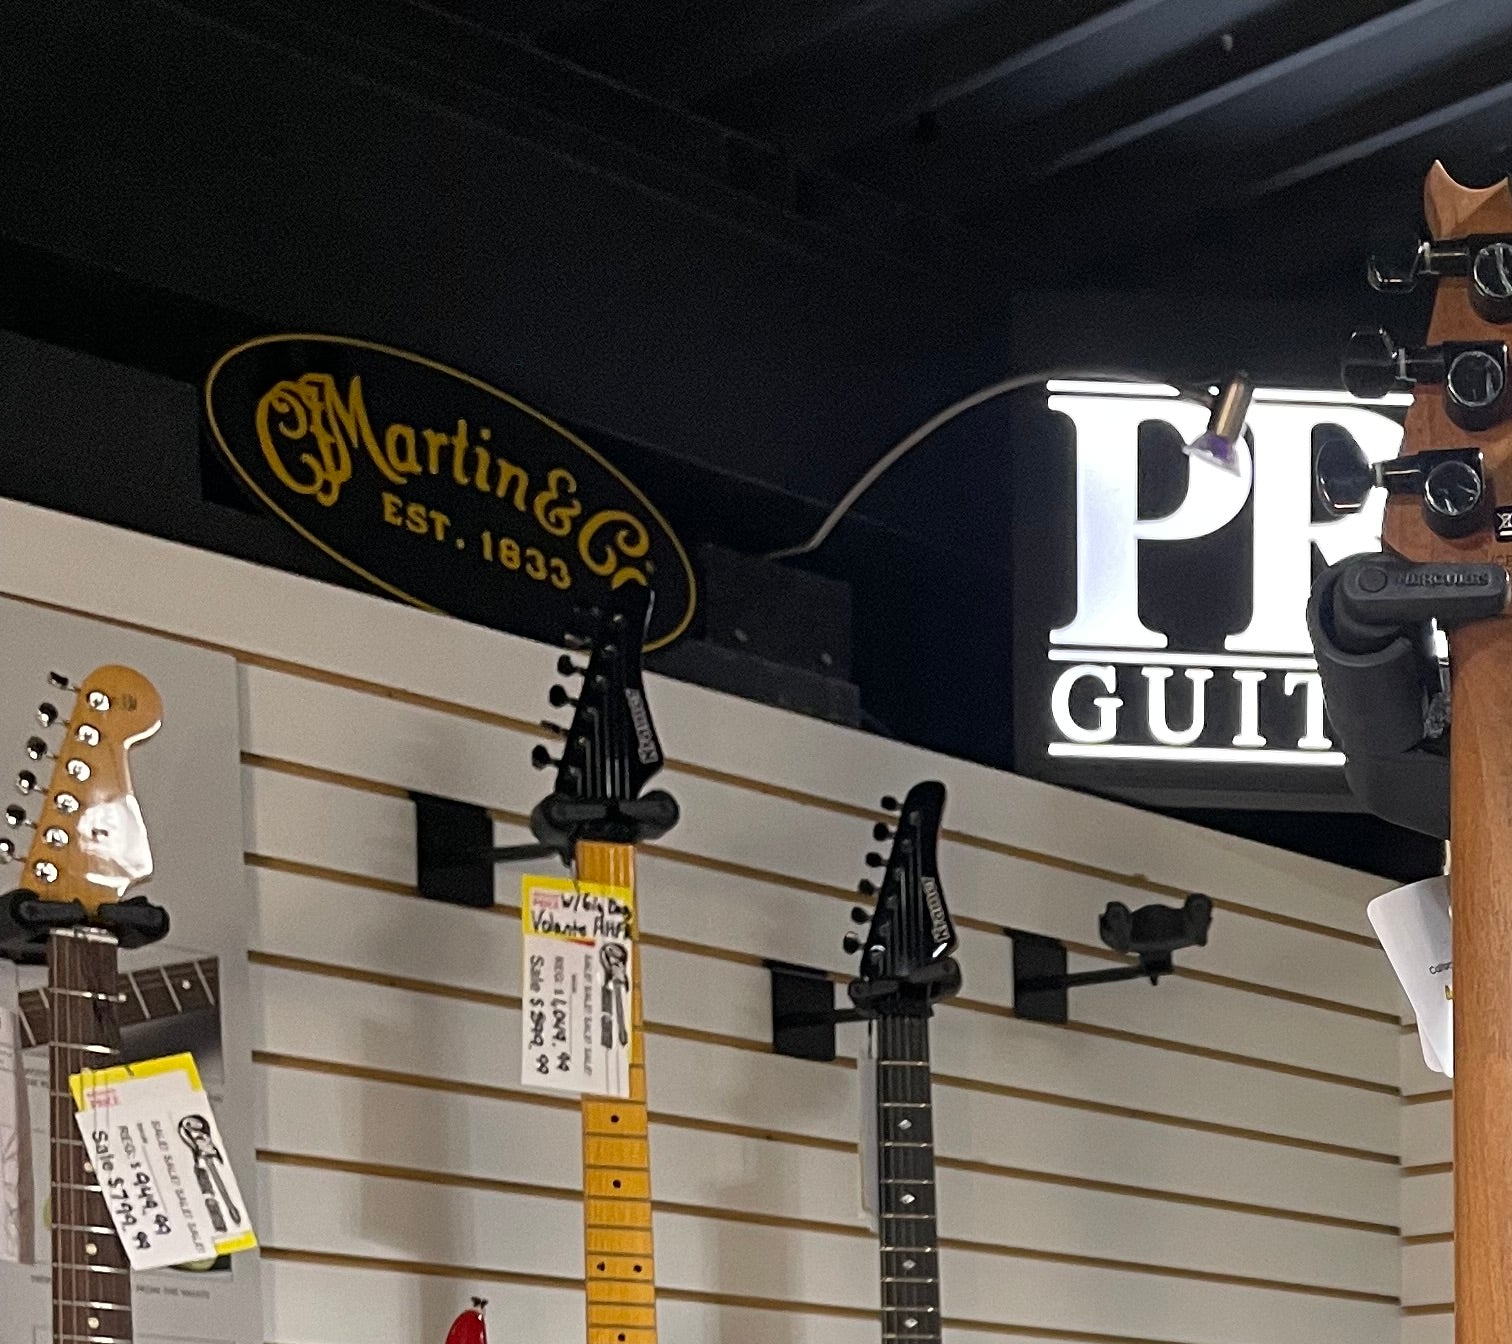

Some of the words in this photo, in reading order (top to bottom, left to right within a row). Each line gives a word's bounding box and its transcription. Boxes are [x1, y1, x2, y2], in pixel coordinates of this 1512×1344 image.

[381, 490, 465, 551] EST.
[480, 530, 571, 591] 1833
[1047, 394, 1405, 655] PR
[1051, 664, 1333, 750] GUIT
[91, 1130, 116, 1172] Sale
